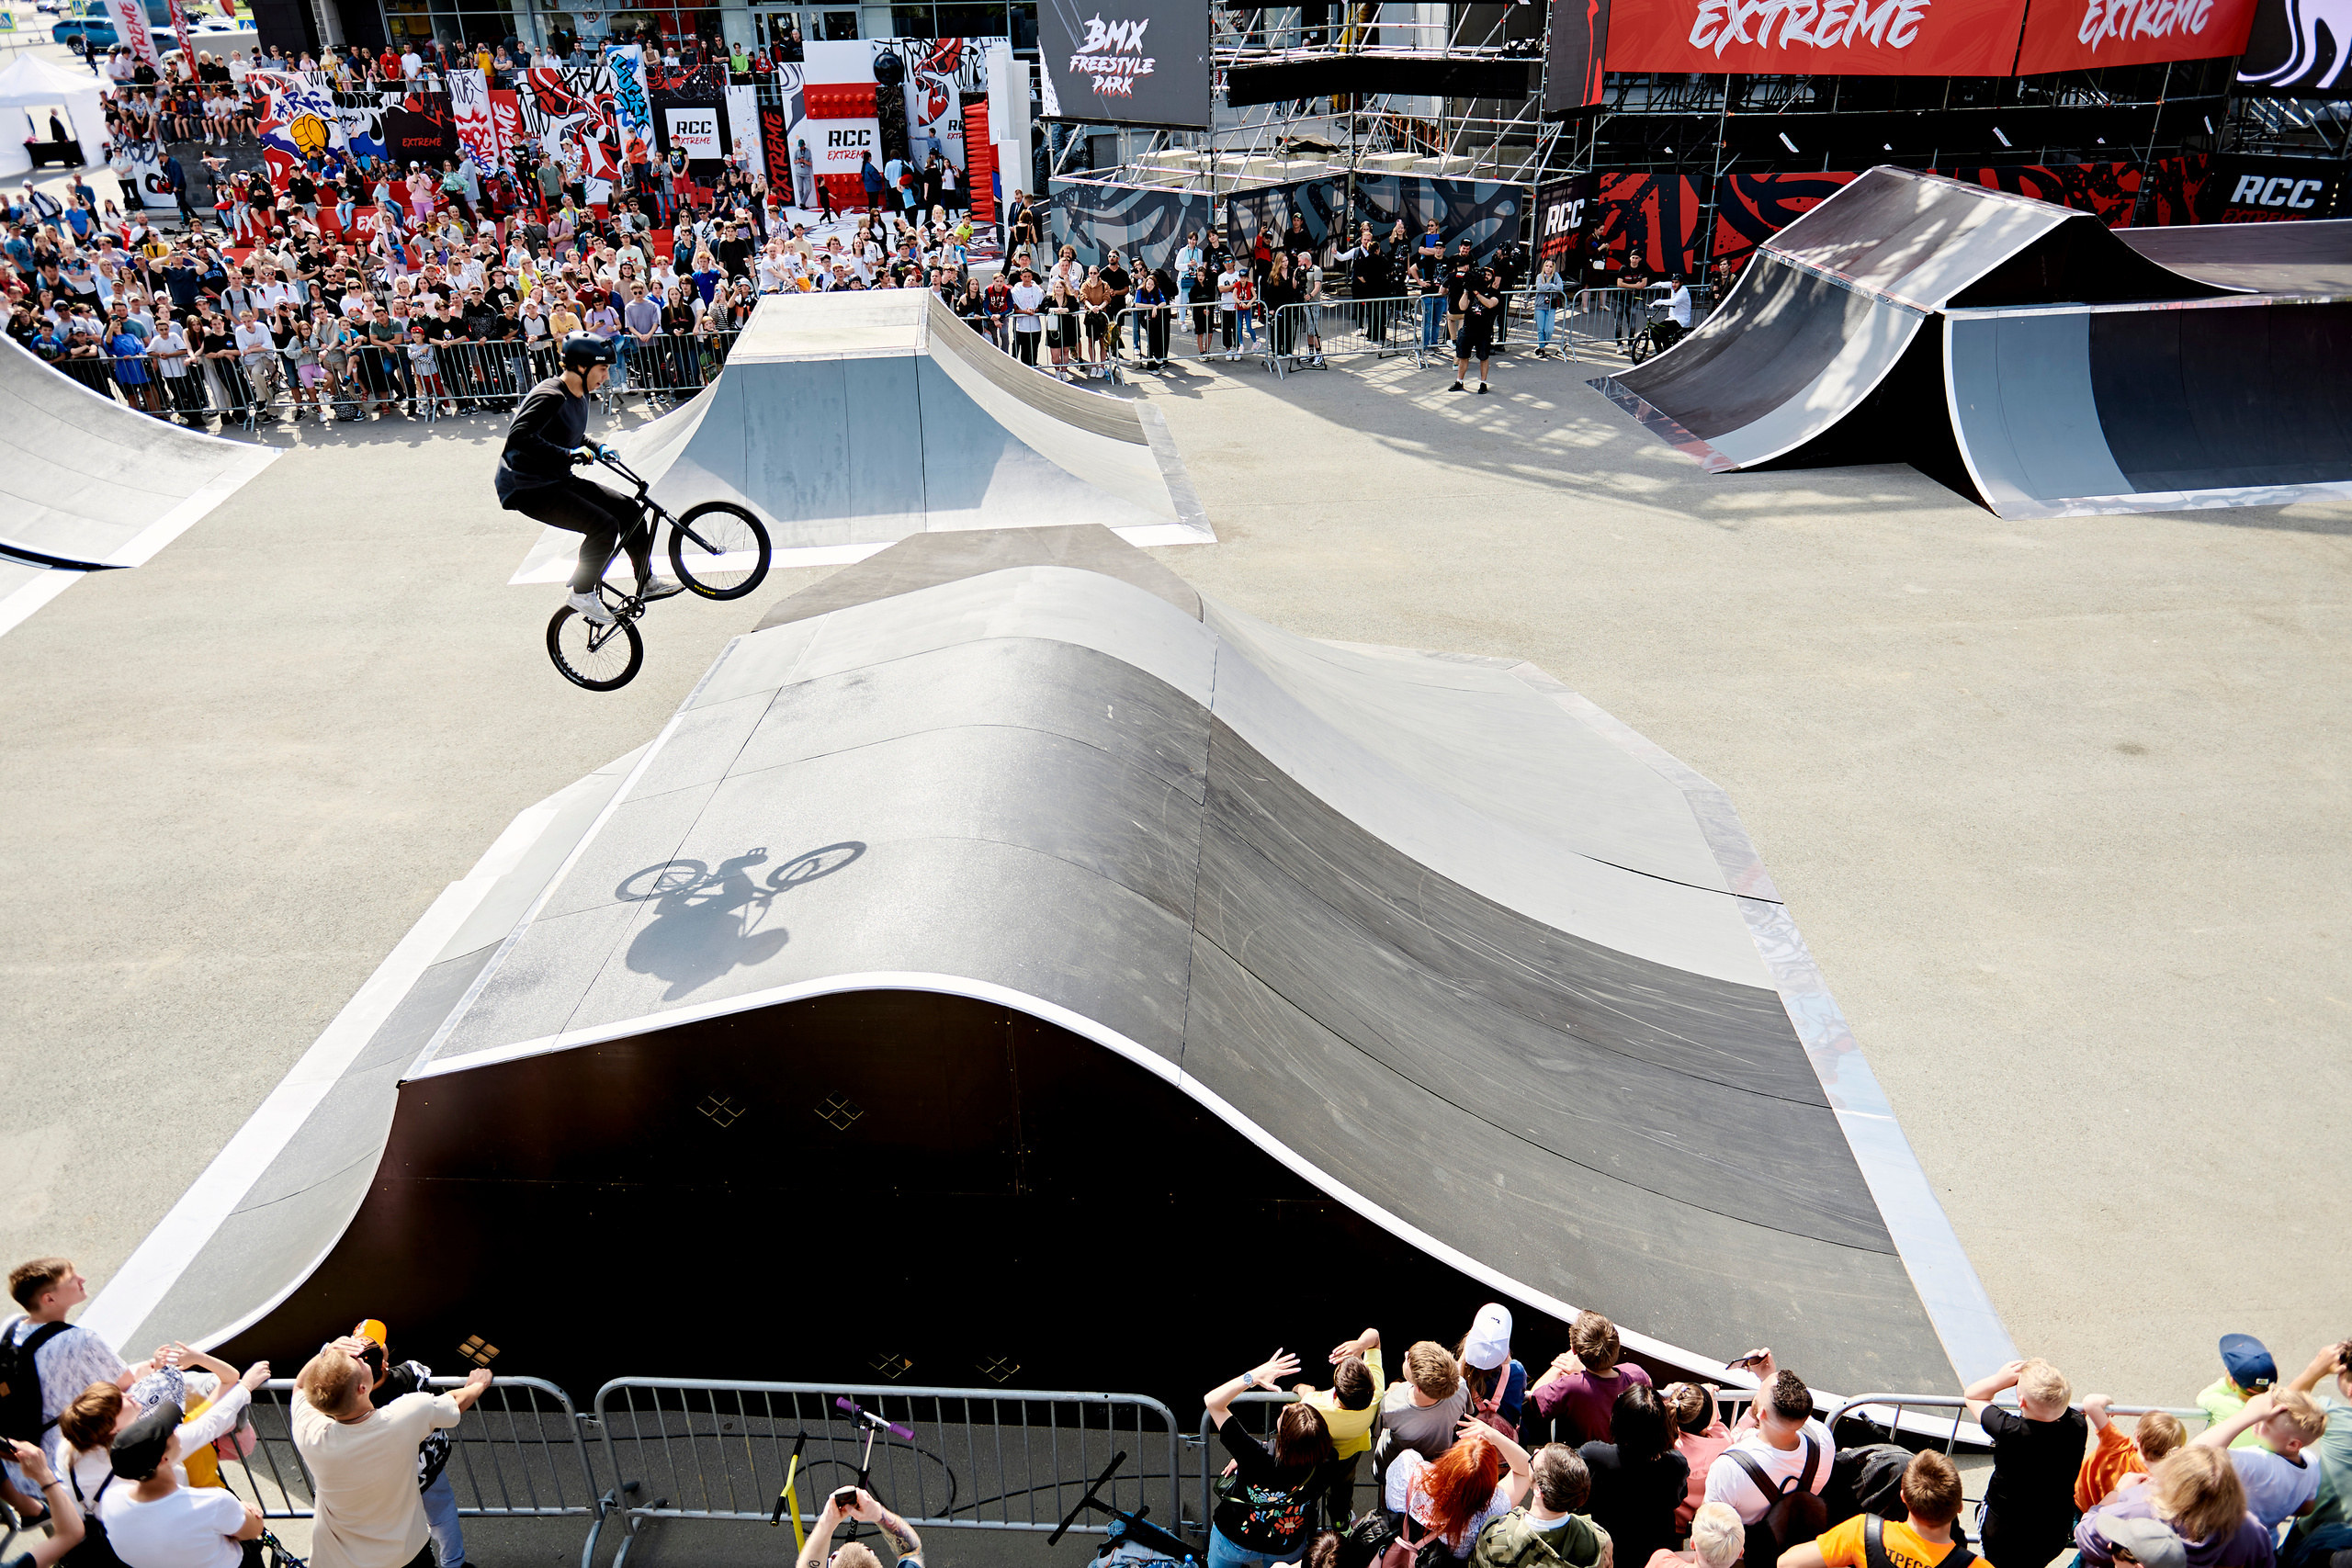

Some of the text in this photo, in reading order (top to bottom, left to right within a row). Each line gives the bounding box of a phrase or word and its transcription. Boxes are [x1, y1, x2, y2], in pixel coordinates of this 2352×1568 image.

[1076, 12, 1149, 55] BMX
[1689, 0, 1931, 60] EXTREME
[2077, 0, 2214, 54] EXTREME
[1069, 54, 1157, 77] FREESTYLE
[1091, 73, 1135, 99] PARK
[676, 120, 712, 135] RCC
[679, 136, 712, 145] XTREME
[828, 129, 871, 147] RCC
[401, 137, 443, 149] EXTREME
[2230, 175, 2324, 209] RCC
[1544, 198, 1585, 237] RCC
